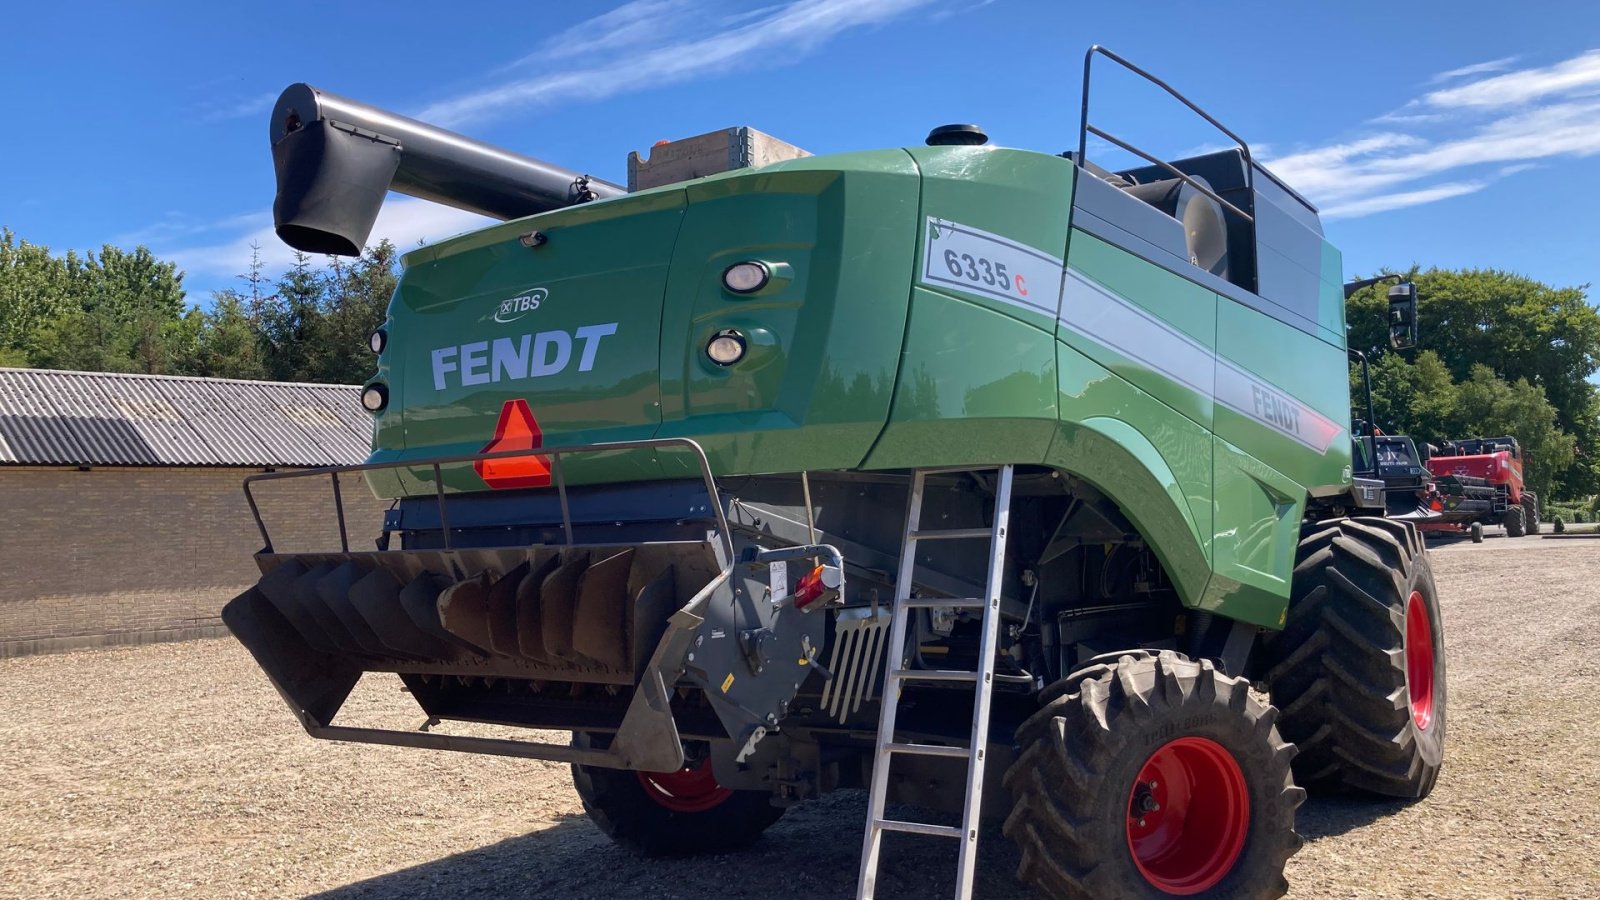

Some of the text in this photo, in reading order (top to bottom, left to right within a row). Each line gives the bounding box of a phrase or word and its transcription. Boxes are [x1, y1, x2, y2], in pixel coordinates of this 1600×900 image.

[943, 248, 1011, 291] 6335
[512, 294, 541, 313] TBS
[431, 322, 619, 391] FENDT
[1251, 384, 1300, 435] FENDT
